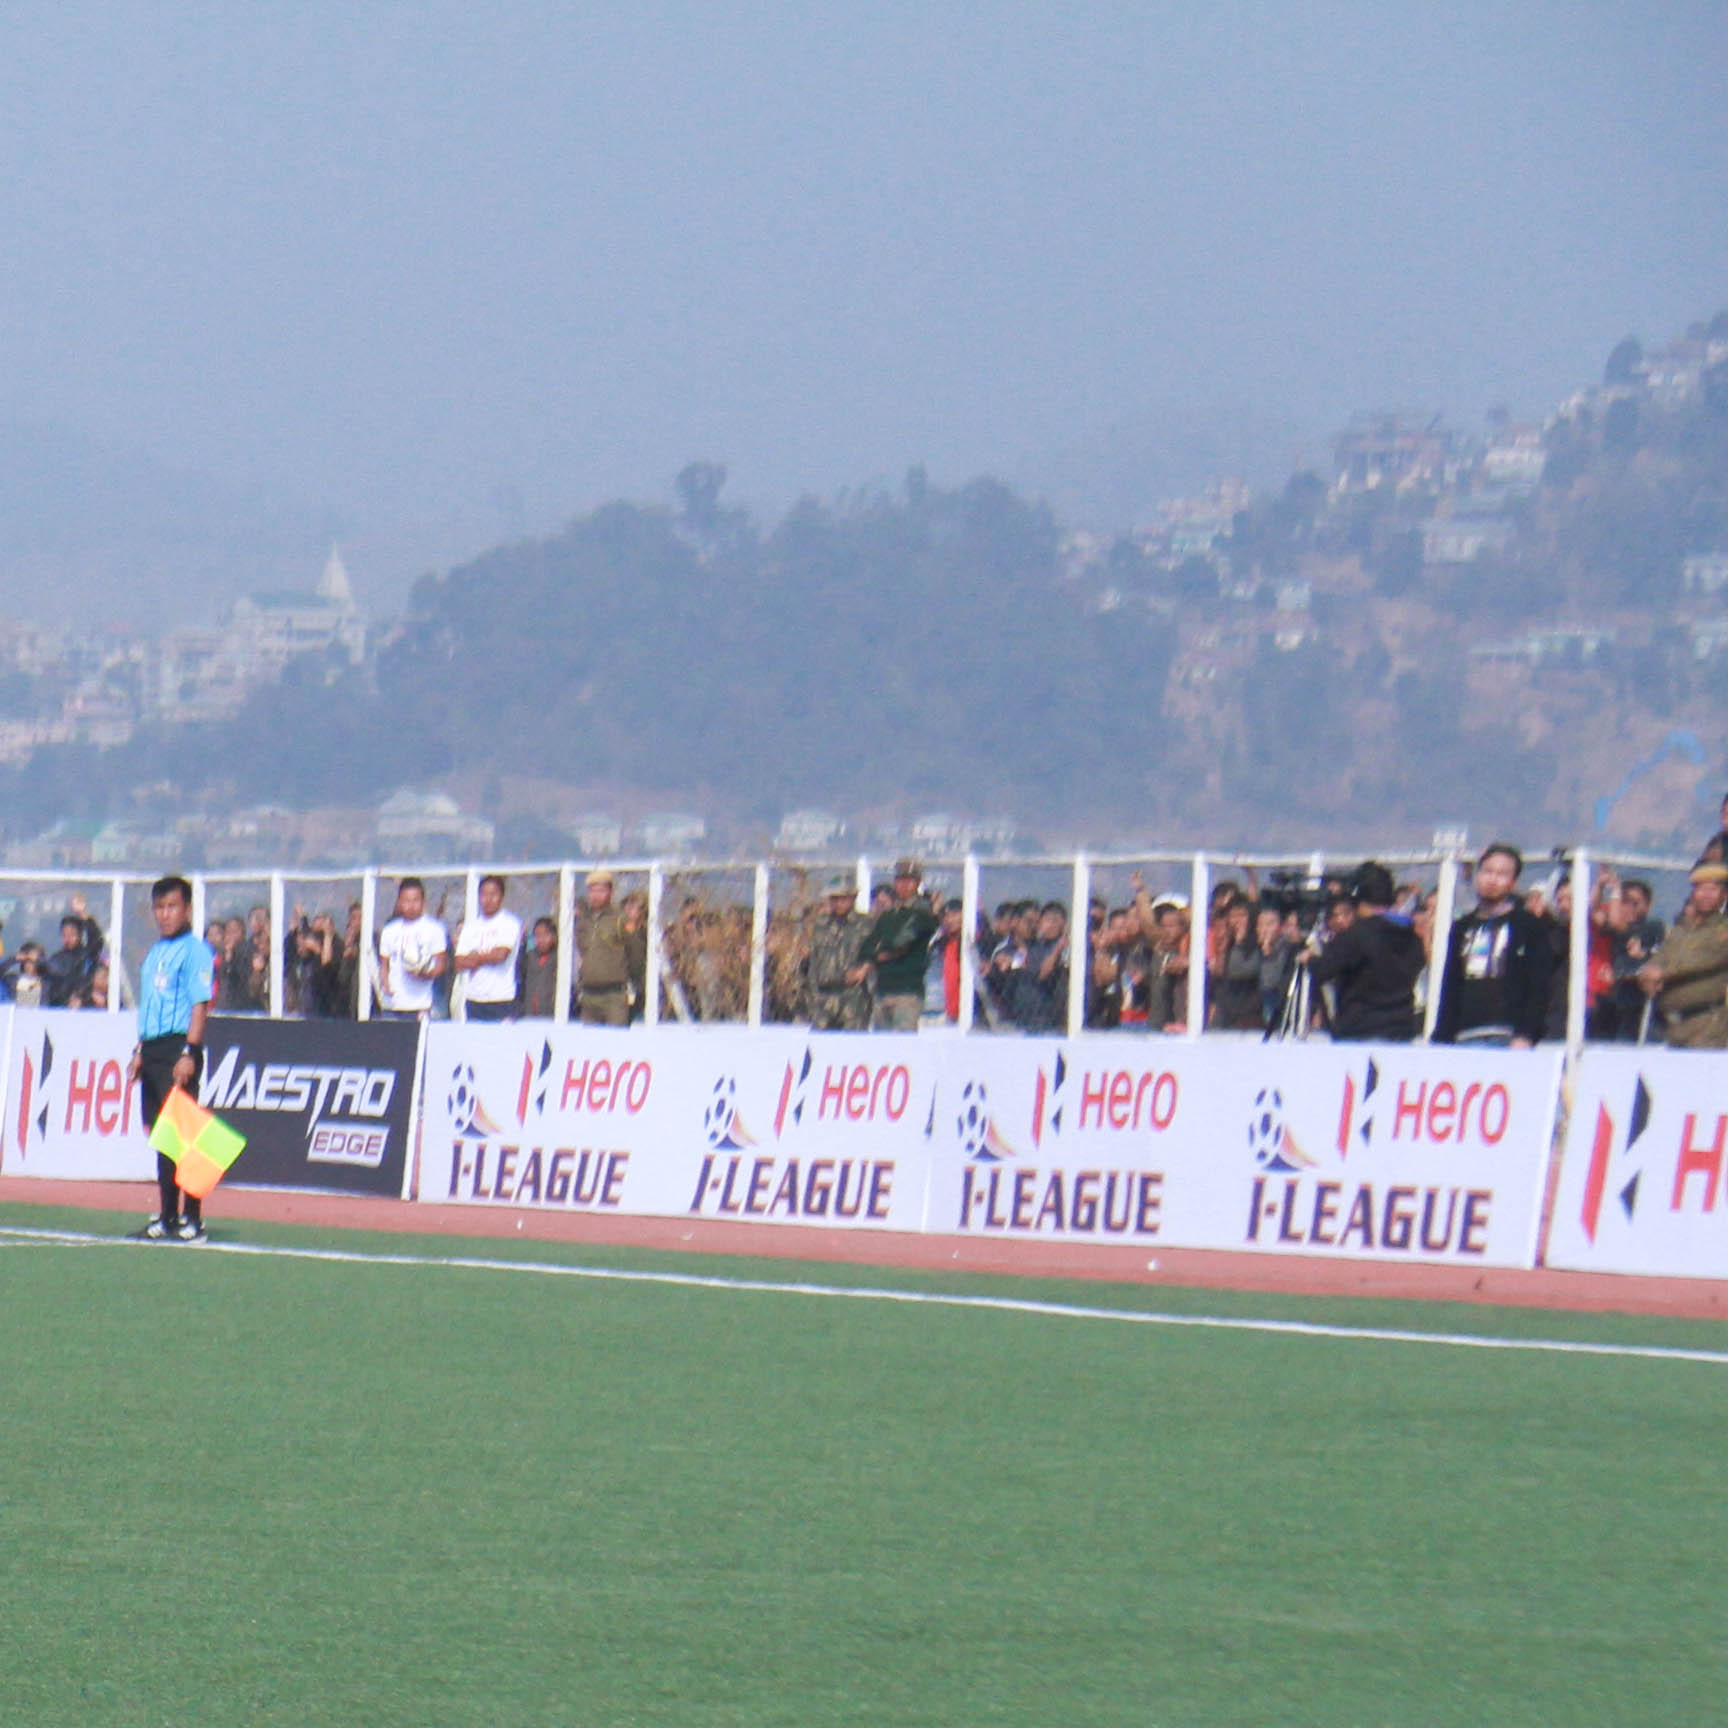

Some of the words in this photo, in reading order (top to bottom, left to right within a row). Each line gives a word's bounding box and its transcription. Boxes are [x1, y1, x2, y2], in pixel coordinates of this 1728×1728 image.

[64, 1057, 142, 1137] Her
[197, 1045, 397, 1138] MAESTRO
[559, 1057, 652, 1115] Hero
[817, 1063, 911, 1122] Hero
[1078, 1070, 1179, 1131] Hero
[1391, 1079, 1511, 1145] Hero
[312, 1130, 384, 1158] EDGE
[448, 1138, 632, 1206] I-LEAGUE
[689, 1153, 896, 1219] I-LEAGUE
[957, 1164, 1164, 1234] I-LEAGUE
[1245, 1175, 1493, 1255] I-LEAGUE
